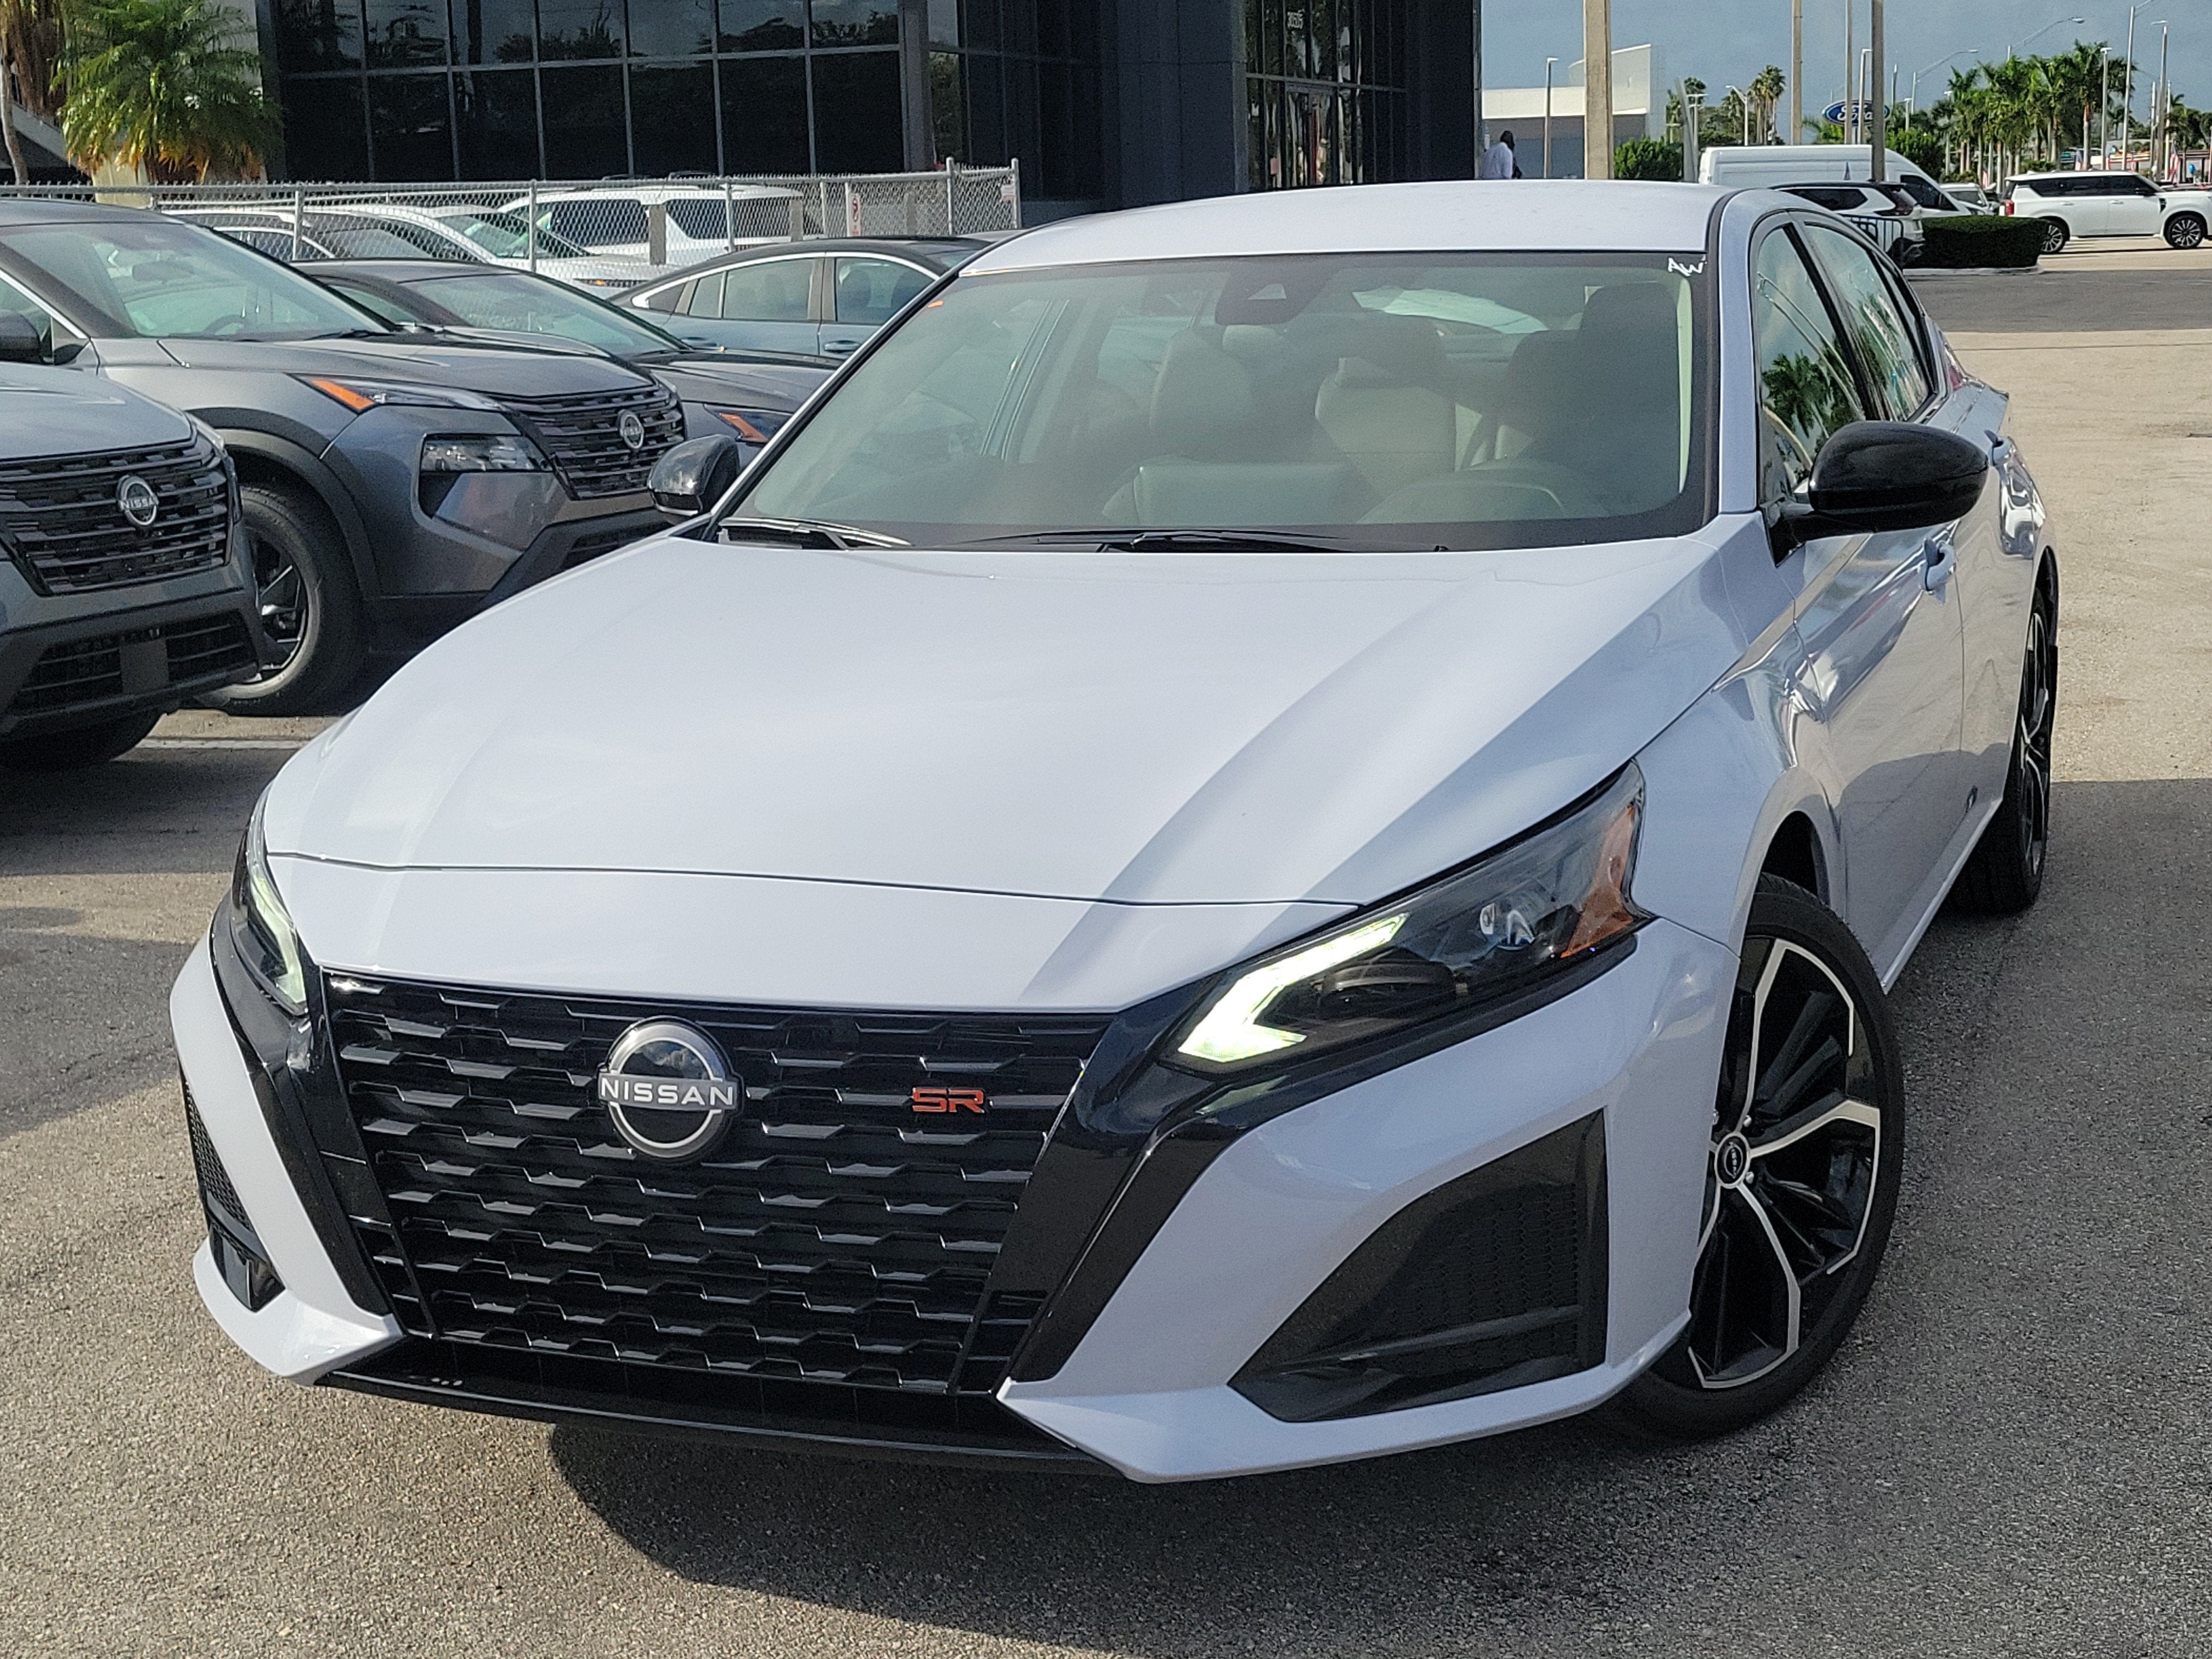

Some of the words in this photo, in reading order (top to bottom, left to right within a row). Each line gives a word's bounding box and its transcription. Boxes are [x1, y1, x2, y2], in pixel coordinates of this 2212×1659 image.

[1837, 104, 1874, 121] Fod
[601, 1077, 733, 1106] NISSAN
[912, 1087, 985, 1114] SR
